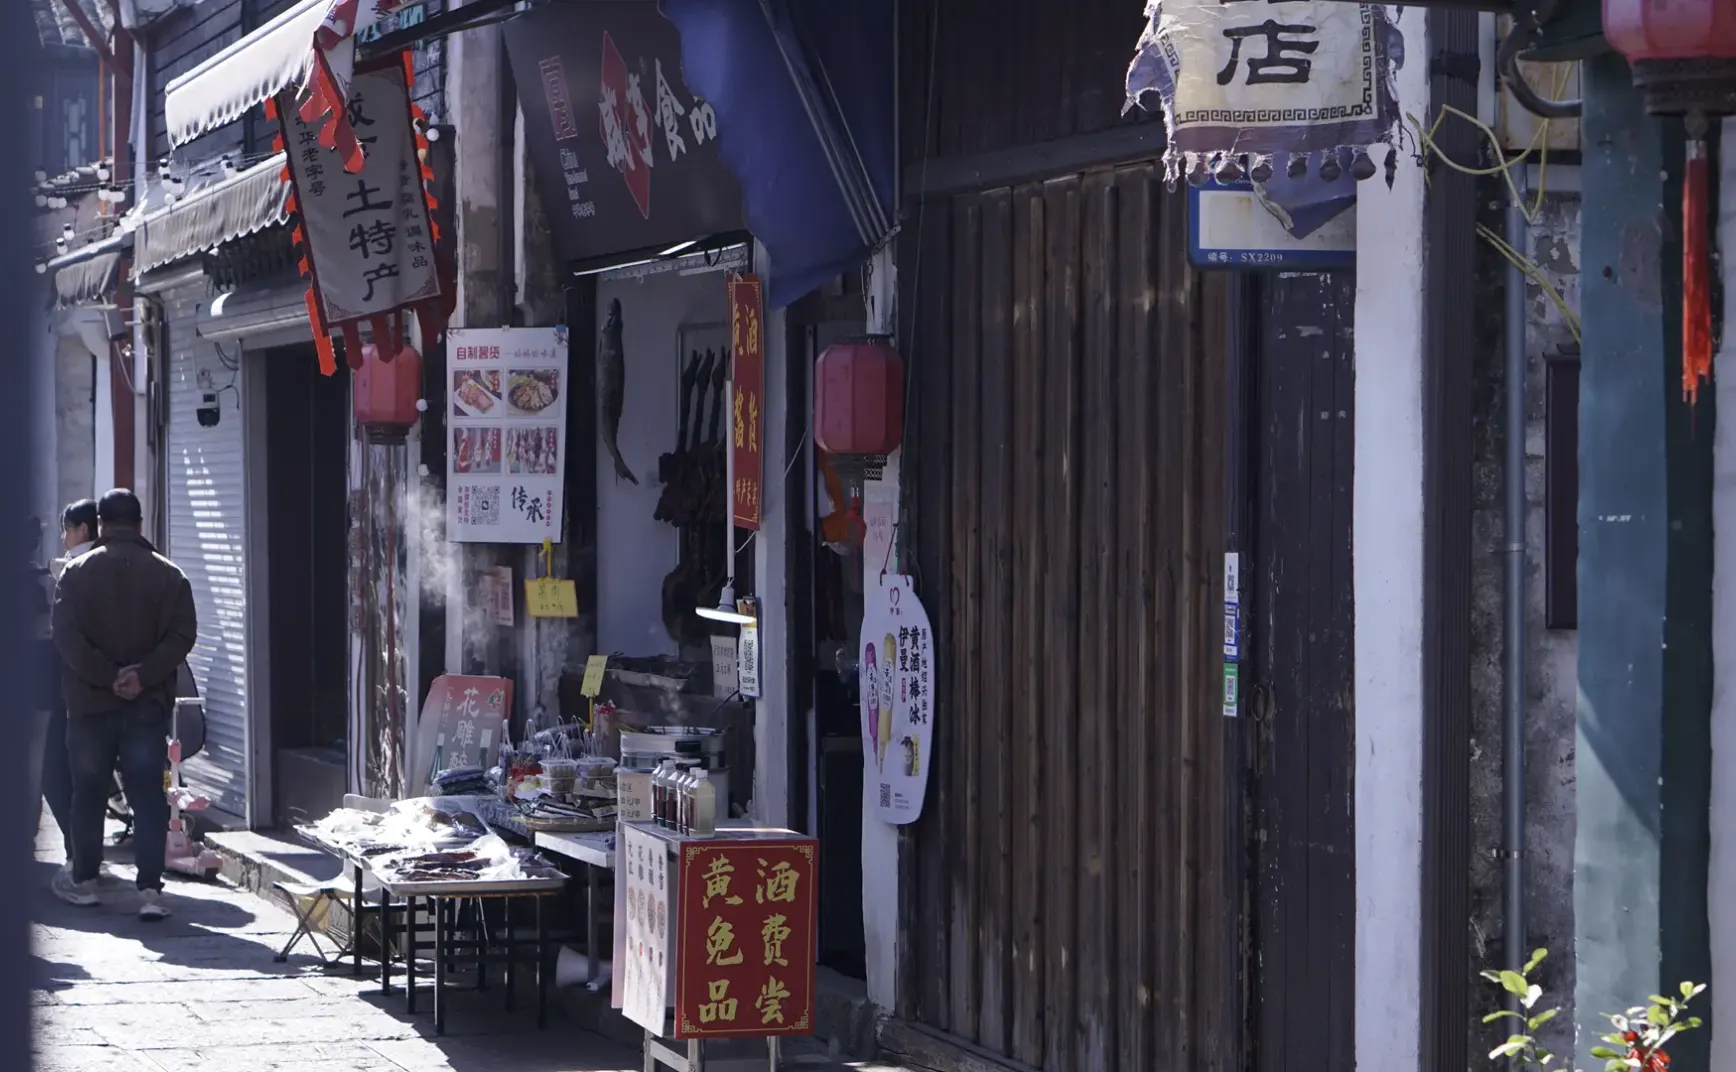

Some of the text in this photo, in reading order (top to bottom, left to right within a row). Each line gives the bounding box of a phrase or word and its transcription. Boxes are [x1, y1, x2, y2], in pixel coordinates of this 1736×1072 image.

[1241, 253, 1283, 262] SX2209
[511, 485, 544, 523] 传承
[899, 625, 910, 672] 伊曼
[702, 854, 800, 909] 黄酒
[706, 913, 792, 967] 免费
[699, 975, 790, 1025] 品尝
